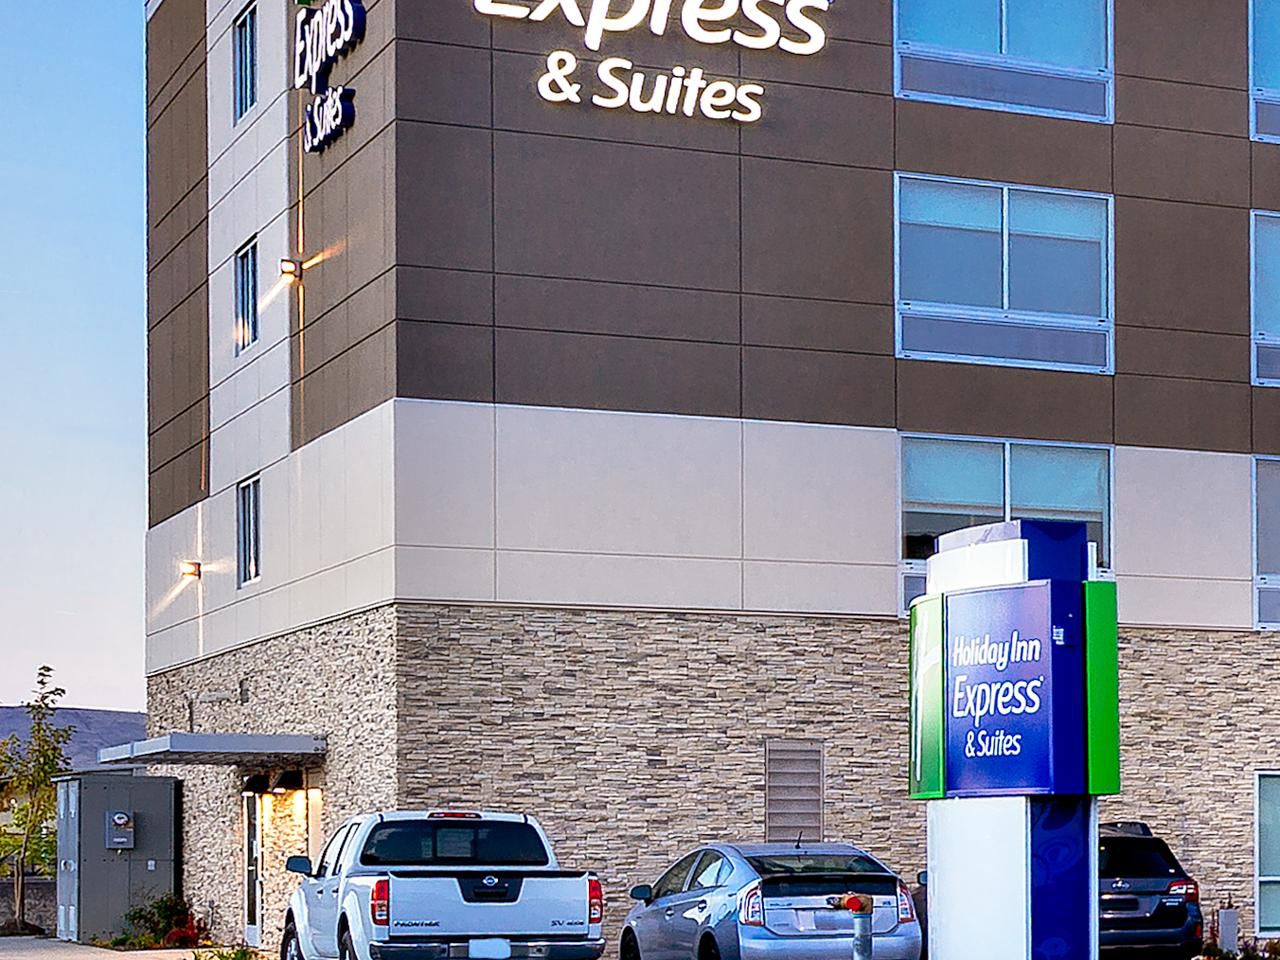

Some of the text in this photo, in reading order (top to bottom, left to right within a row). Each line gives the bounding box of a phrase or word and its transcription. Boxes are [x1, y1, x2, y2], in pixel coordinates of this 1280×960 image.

[537, 50, 764, 123] & Suites
[953, 634, 1009, 671] Holiday
[1010, 630, 1041, 663] Inn
[953, 675, 1041, 727] Express
[965, 730, 1021, 757] & Suites
